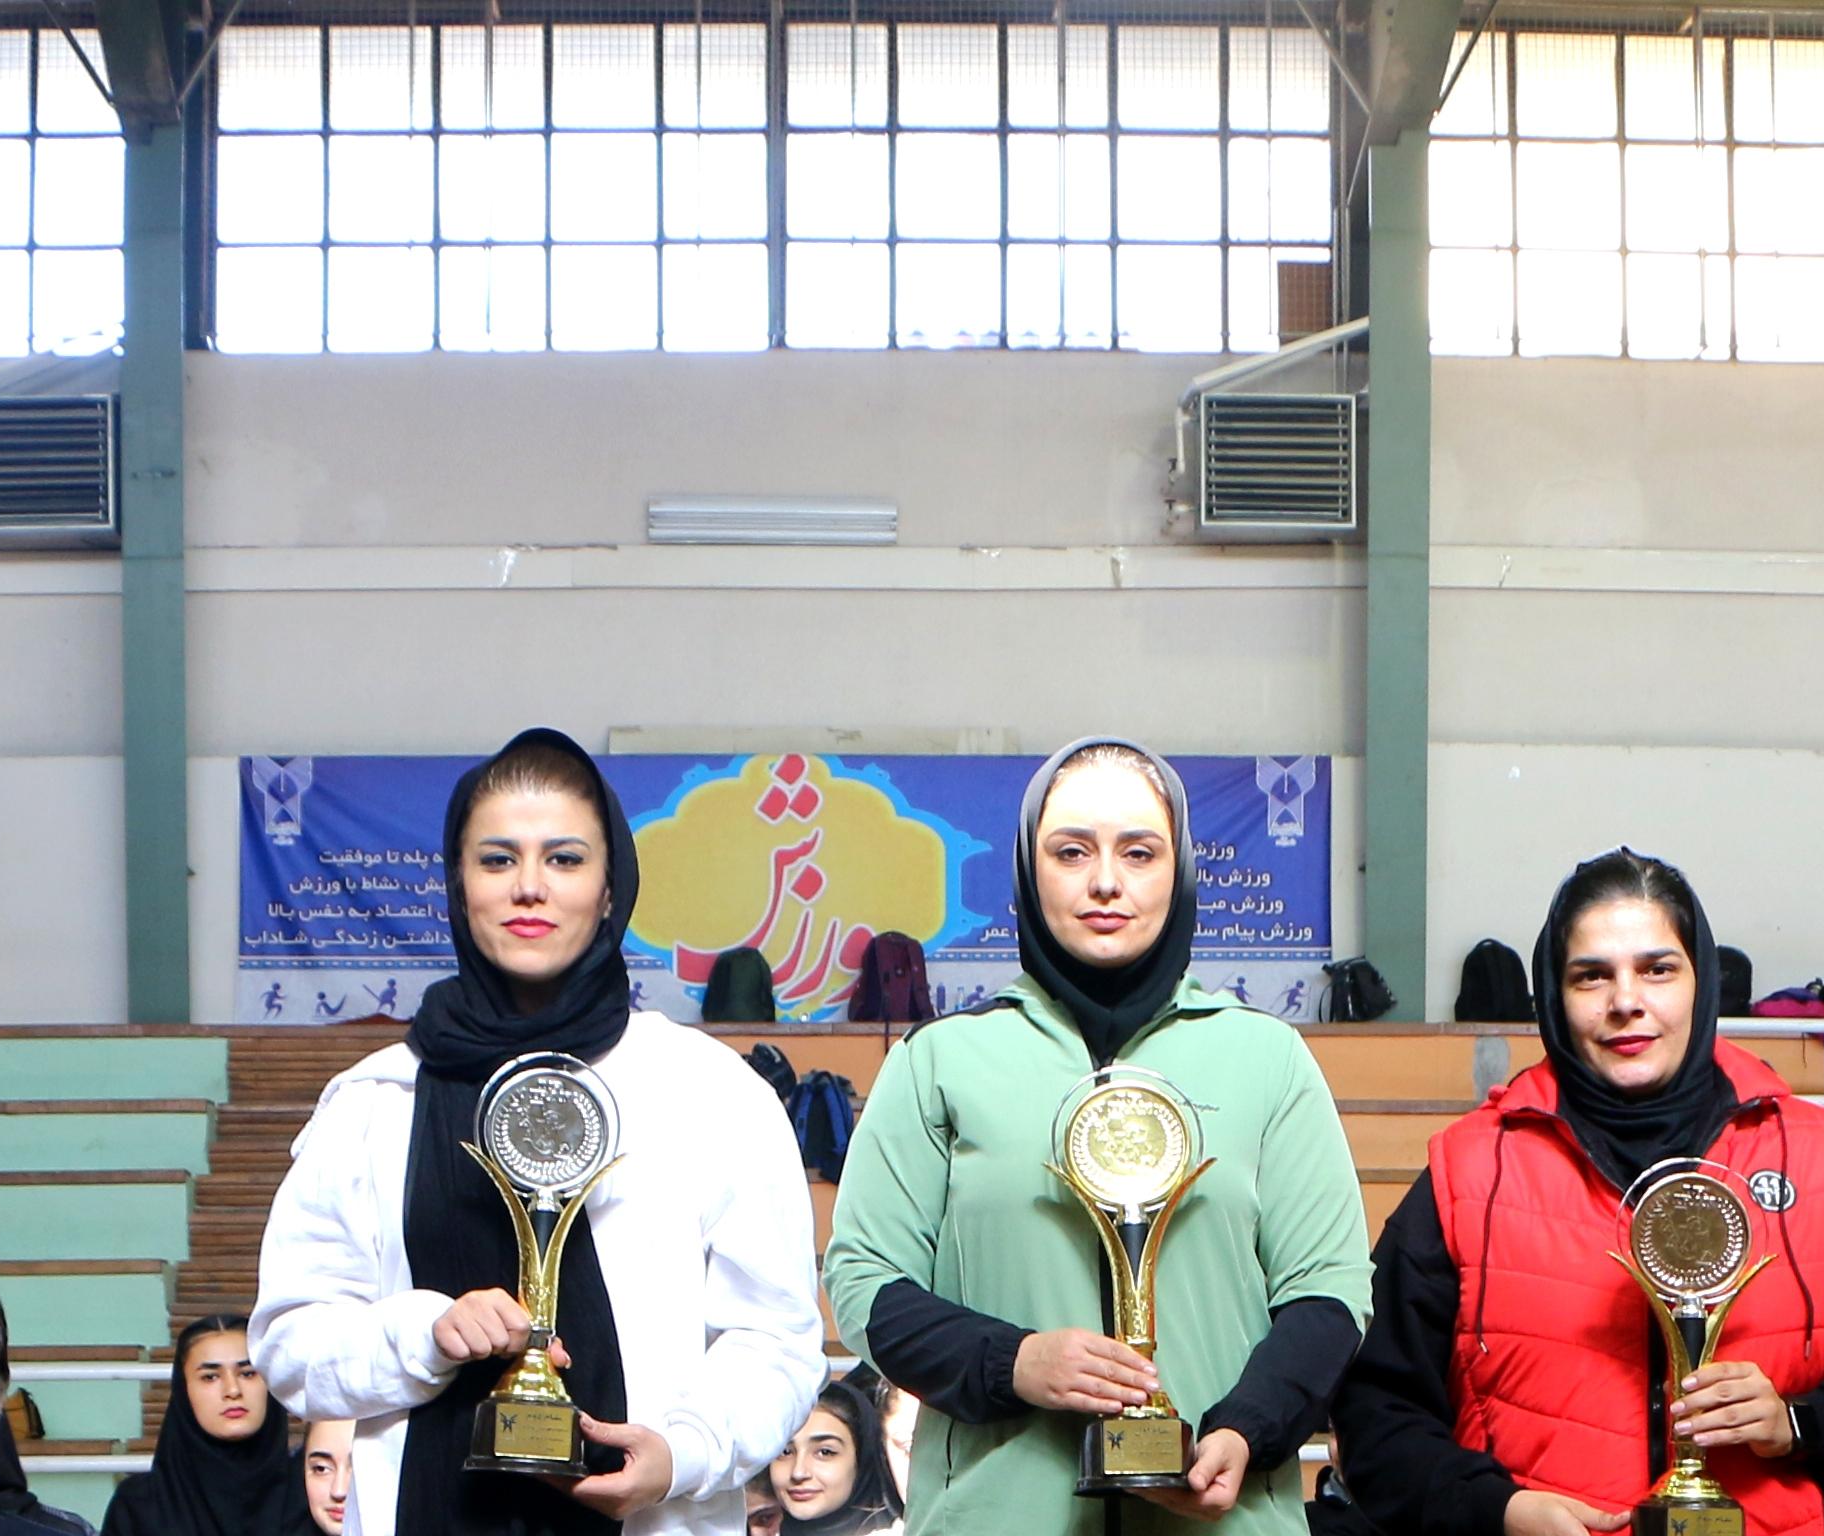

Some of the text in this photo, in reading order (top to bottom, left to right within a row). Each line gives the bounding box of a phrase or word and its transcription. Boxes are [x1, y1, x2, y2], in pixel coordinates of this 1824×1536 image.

[319, 850, 383, 867] موفقیت
[386, 849, 400, 863] تا
[403, 849, 429, 870] پله
[288, 877, 341, 895] ورزش
[345, 878, 358, 893] با
[361, 876, 401, 891] نشاط
[1218, 868, 1271, 887] ورزش
[267, 903, 294, 919] بالا
[298, 905, 344, 921] نفس
[347, 905, 371, 921] به
[375, 903, 433, 918] اعتماد
[1231, 895, 1284, 914] ورزش
[243, 929, 453, 949] داشتن زندگی شاداب
[1222, 922, 1256, 943] پیام
[1260, 921, 1313, 941] ورزش
